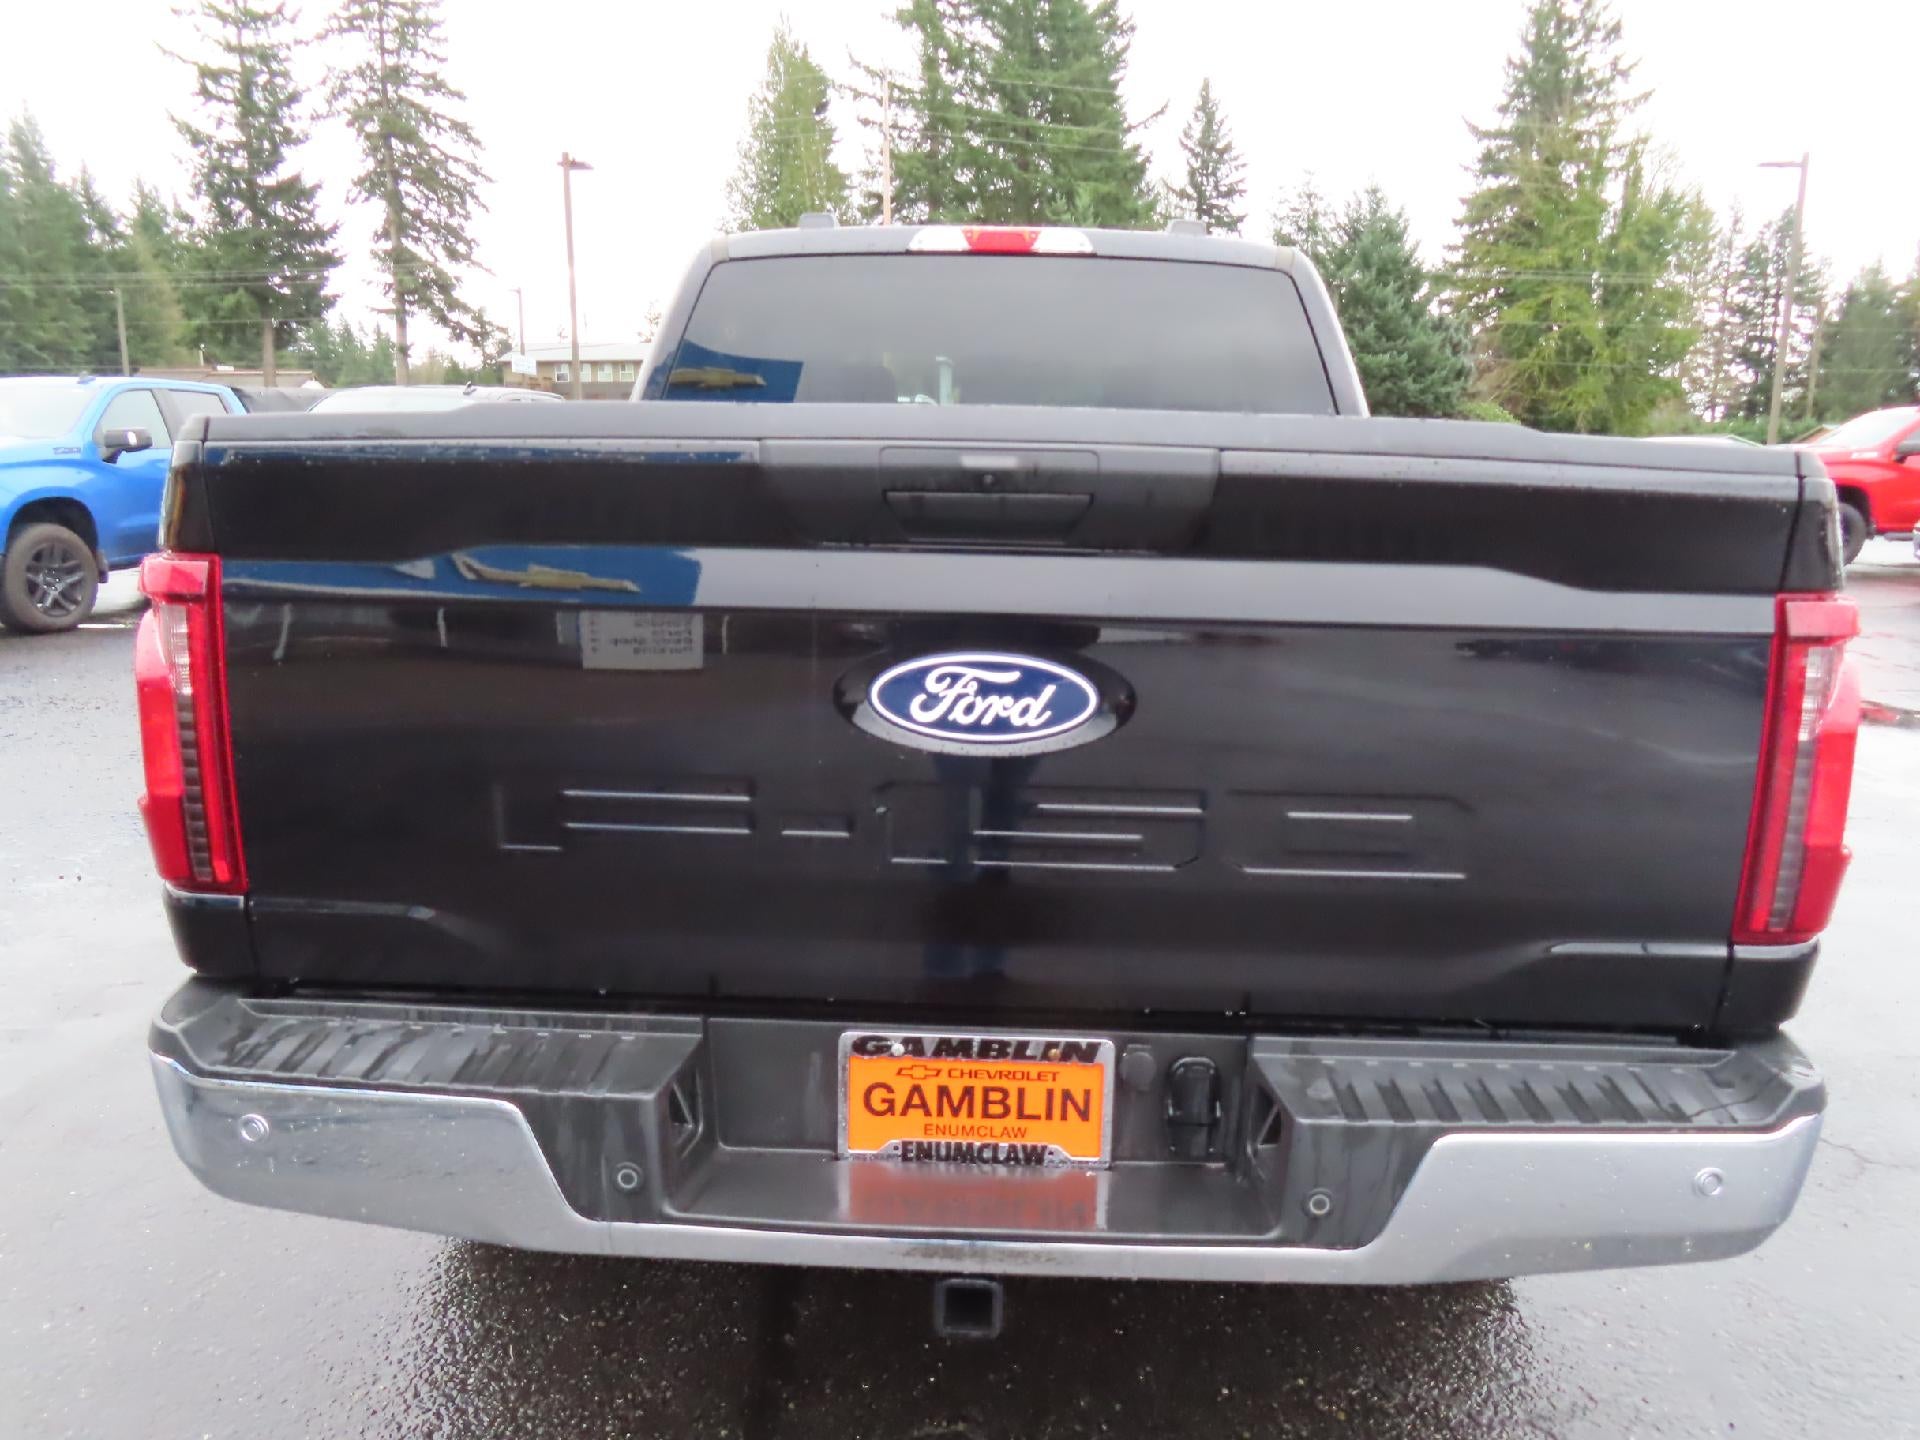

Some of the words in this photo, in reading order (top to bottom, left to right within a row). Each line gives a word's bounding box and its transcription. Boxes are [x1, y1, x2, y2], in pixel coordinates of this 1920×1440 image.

[909, 665, 1056, 727] Ford
[851, 1035, 1100, 1063] GAMBLIN
[947, 1067, 1060, 1083] CHEVROLET
[863, 1081, 1092, 1122] GAMBLIN
[923, 1122, 1028, 1139] ENUMCLAW
[901, 1140, 1048, 1165] ENUMCLAW
